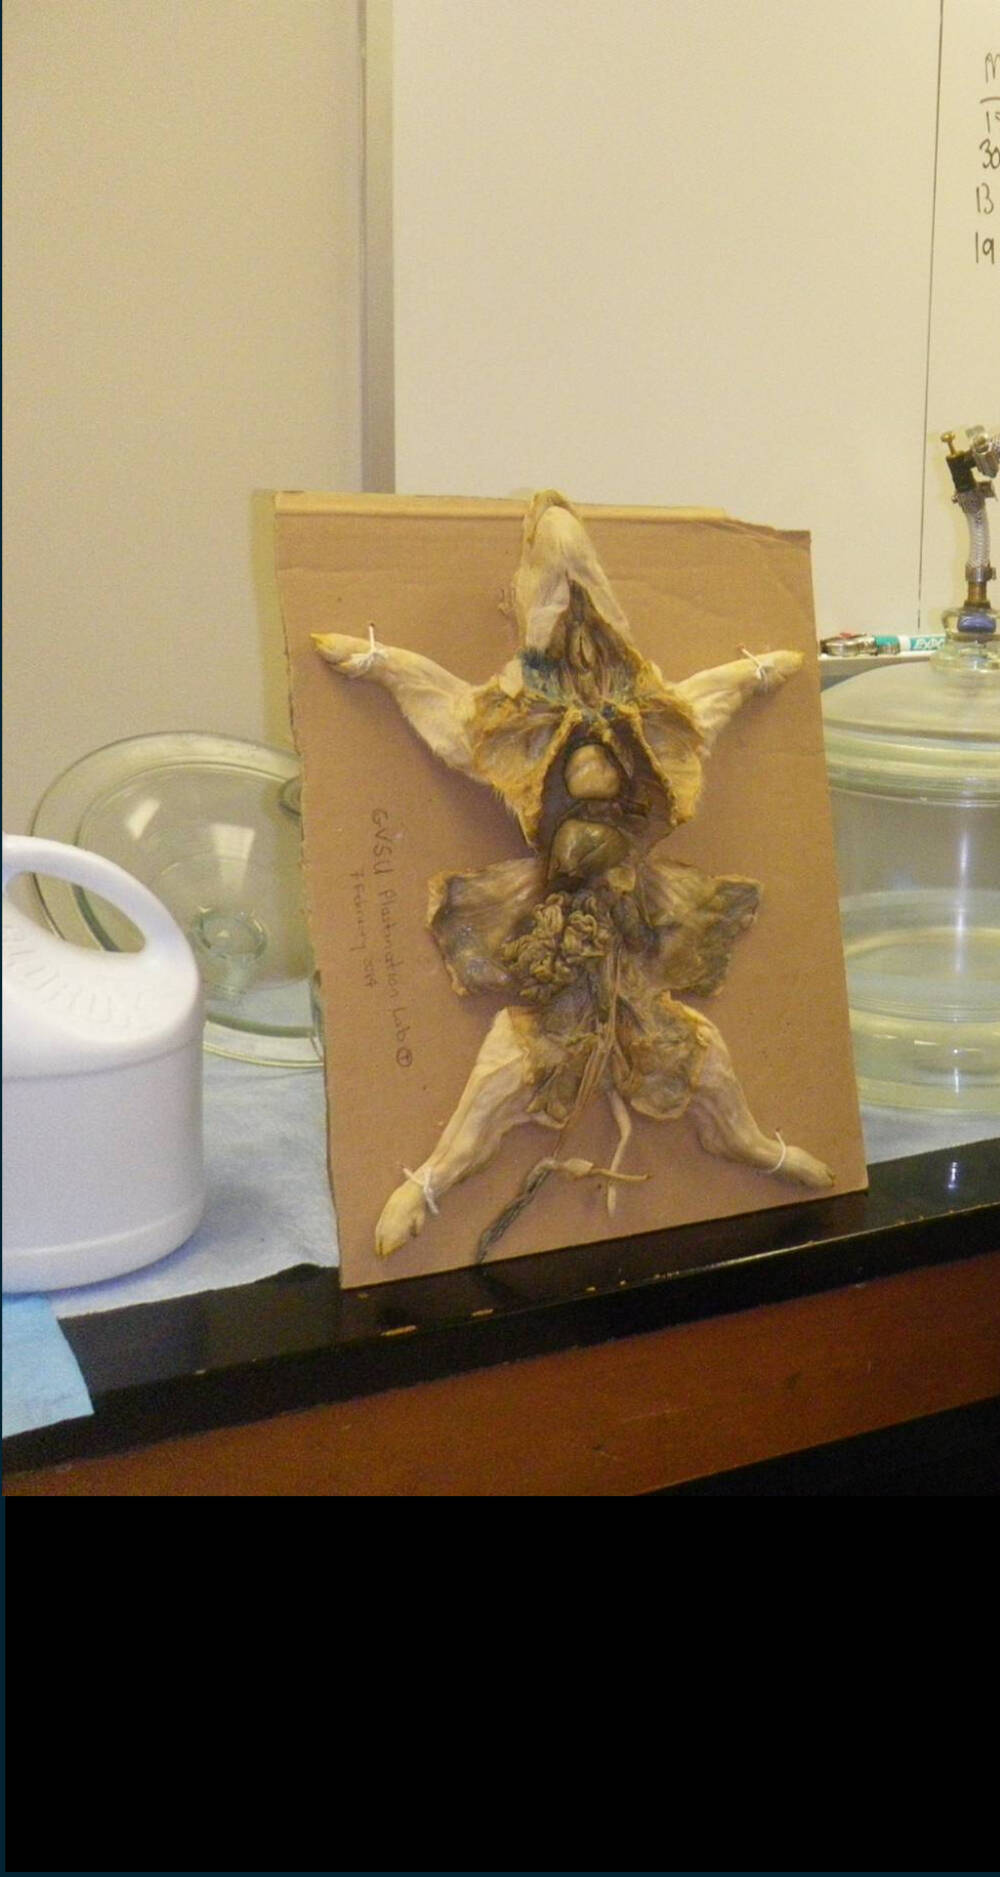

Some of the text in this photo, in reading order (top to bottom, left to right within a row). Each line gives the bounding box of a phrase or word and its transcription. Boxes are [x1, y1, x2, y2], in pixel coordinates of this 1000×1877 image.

[976, 183, 994, 215] 13
[974, 231, 995, 266] 19
[371, 808, 394, 875] GVSU
[390, 1006, 411, 1043] Lab
